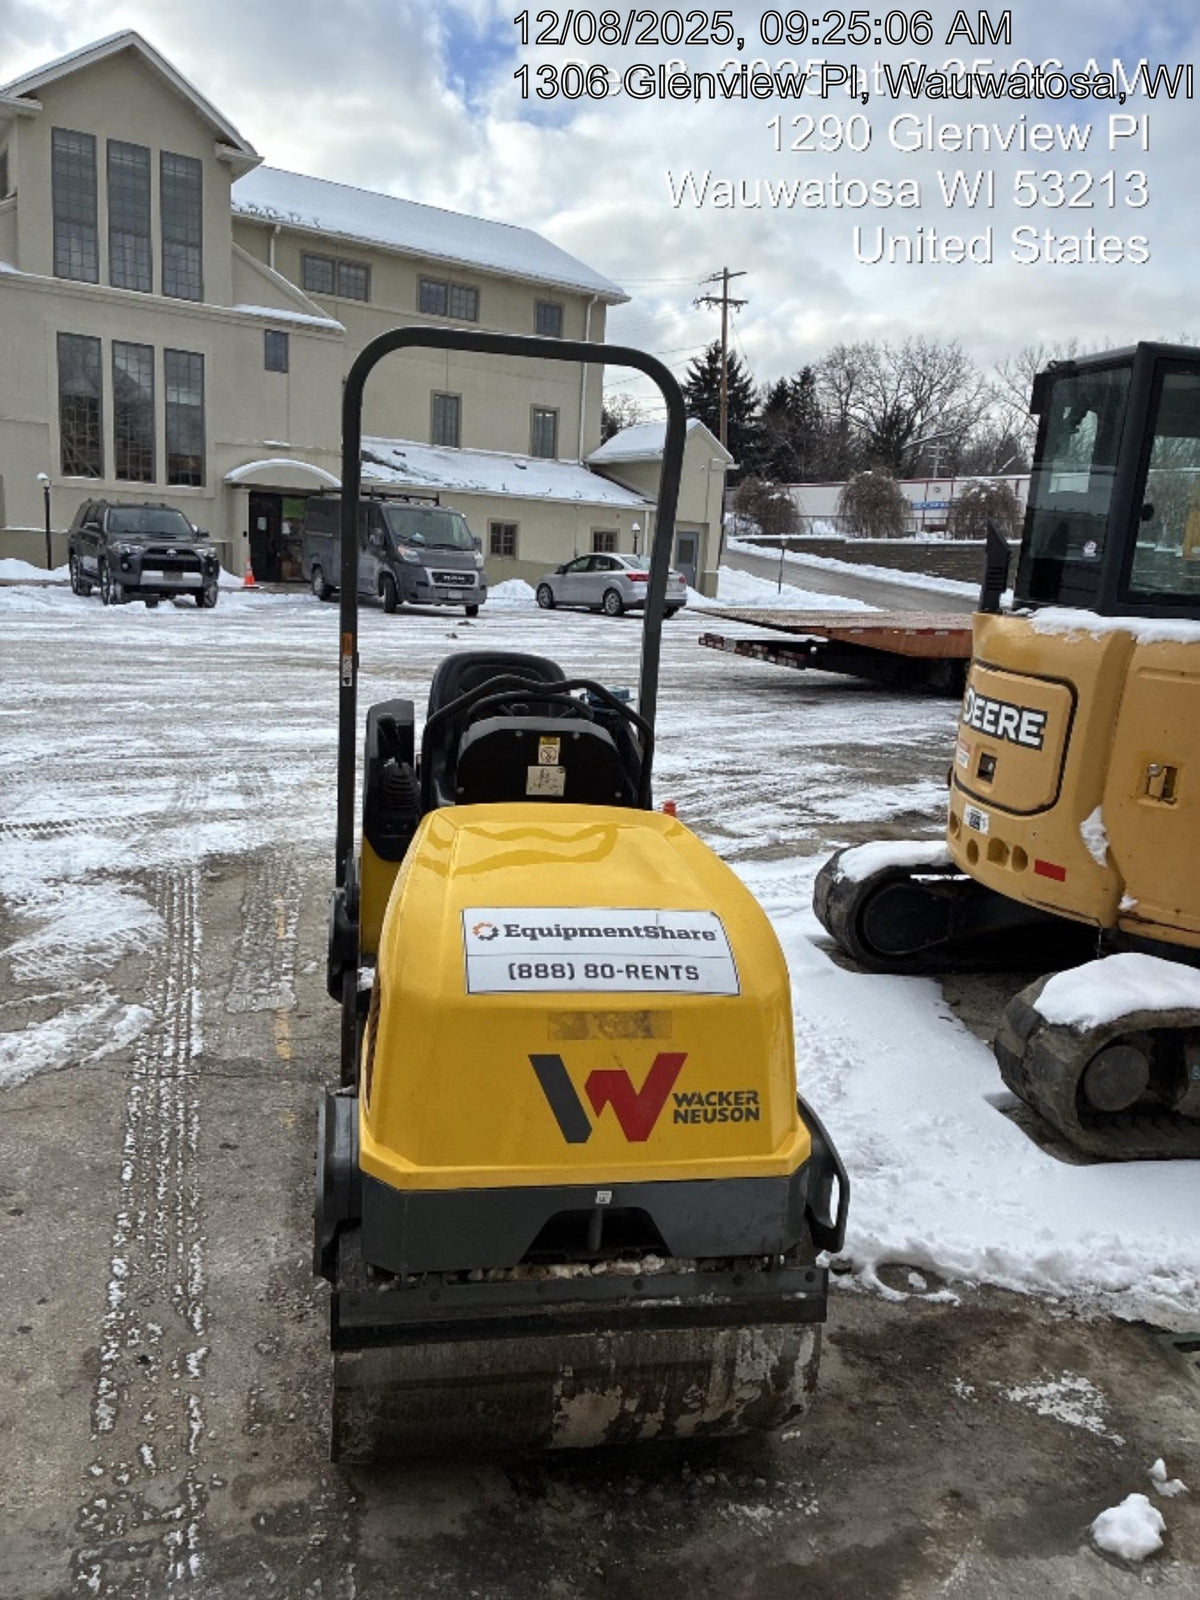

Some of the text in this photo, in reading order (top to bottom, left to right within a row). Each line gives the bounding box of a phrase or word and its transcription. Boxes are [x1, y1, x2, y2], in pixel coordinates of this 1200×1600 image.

[963, 686, 1045, 746] DEERE
[504, 923, 717, 942] EquipmentShare
[508, 962, 700, 981] (888) 80-RENTS
[672, 1090, 760, 1107] WACKER
[673, 1107, 760, 1124] NEUSON
